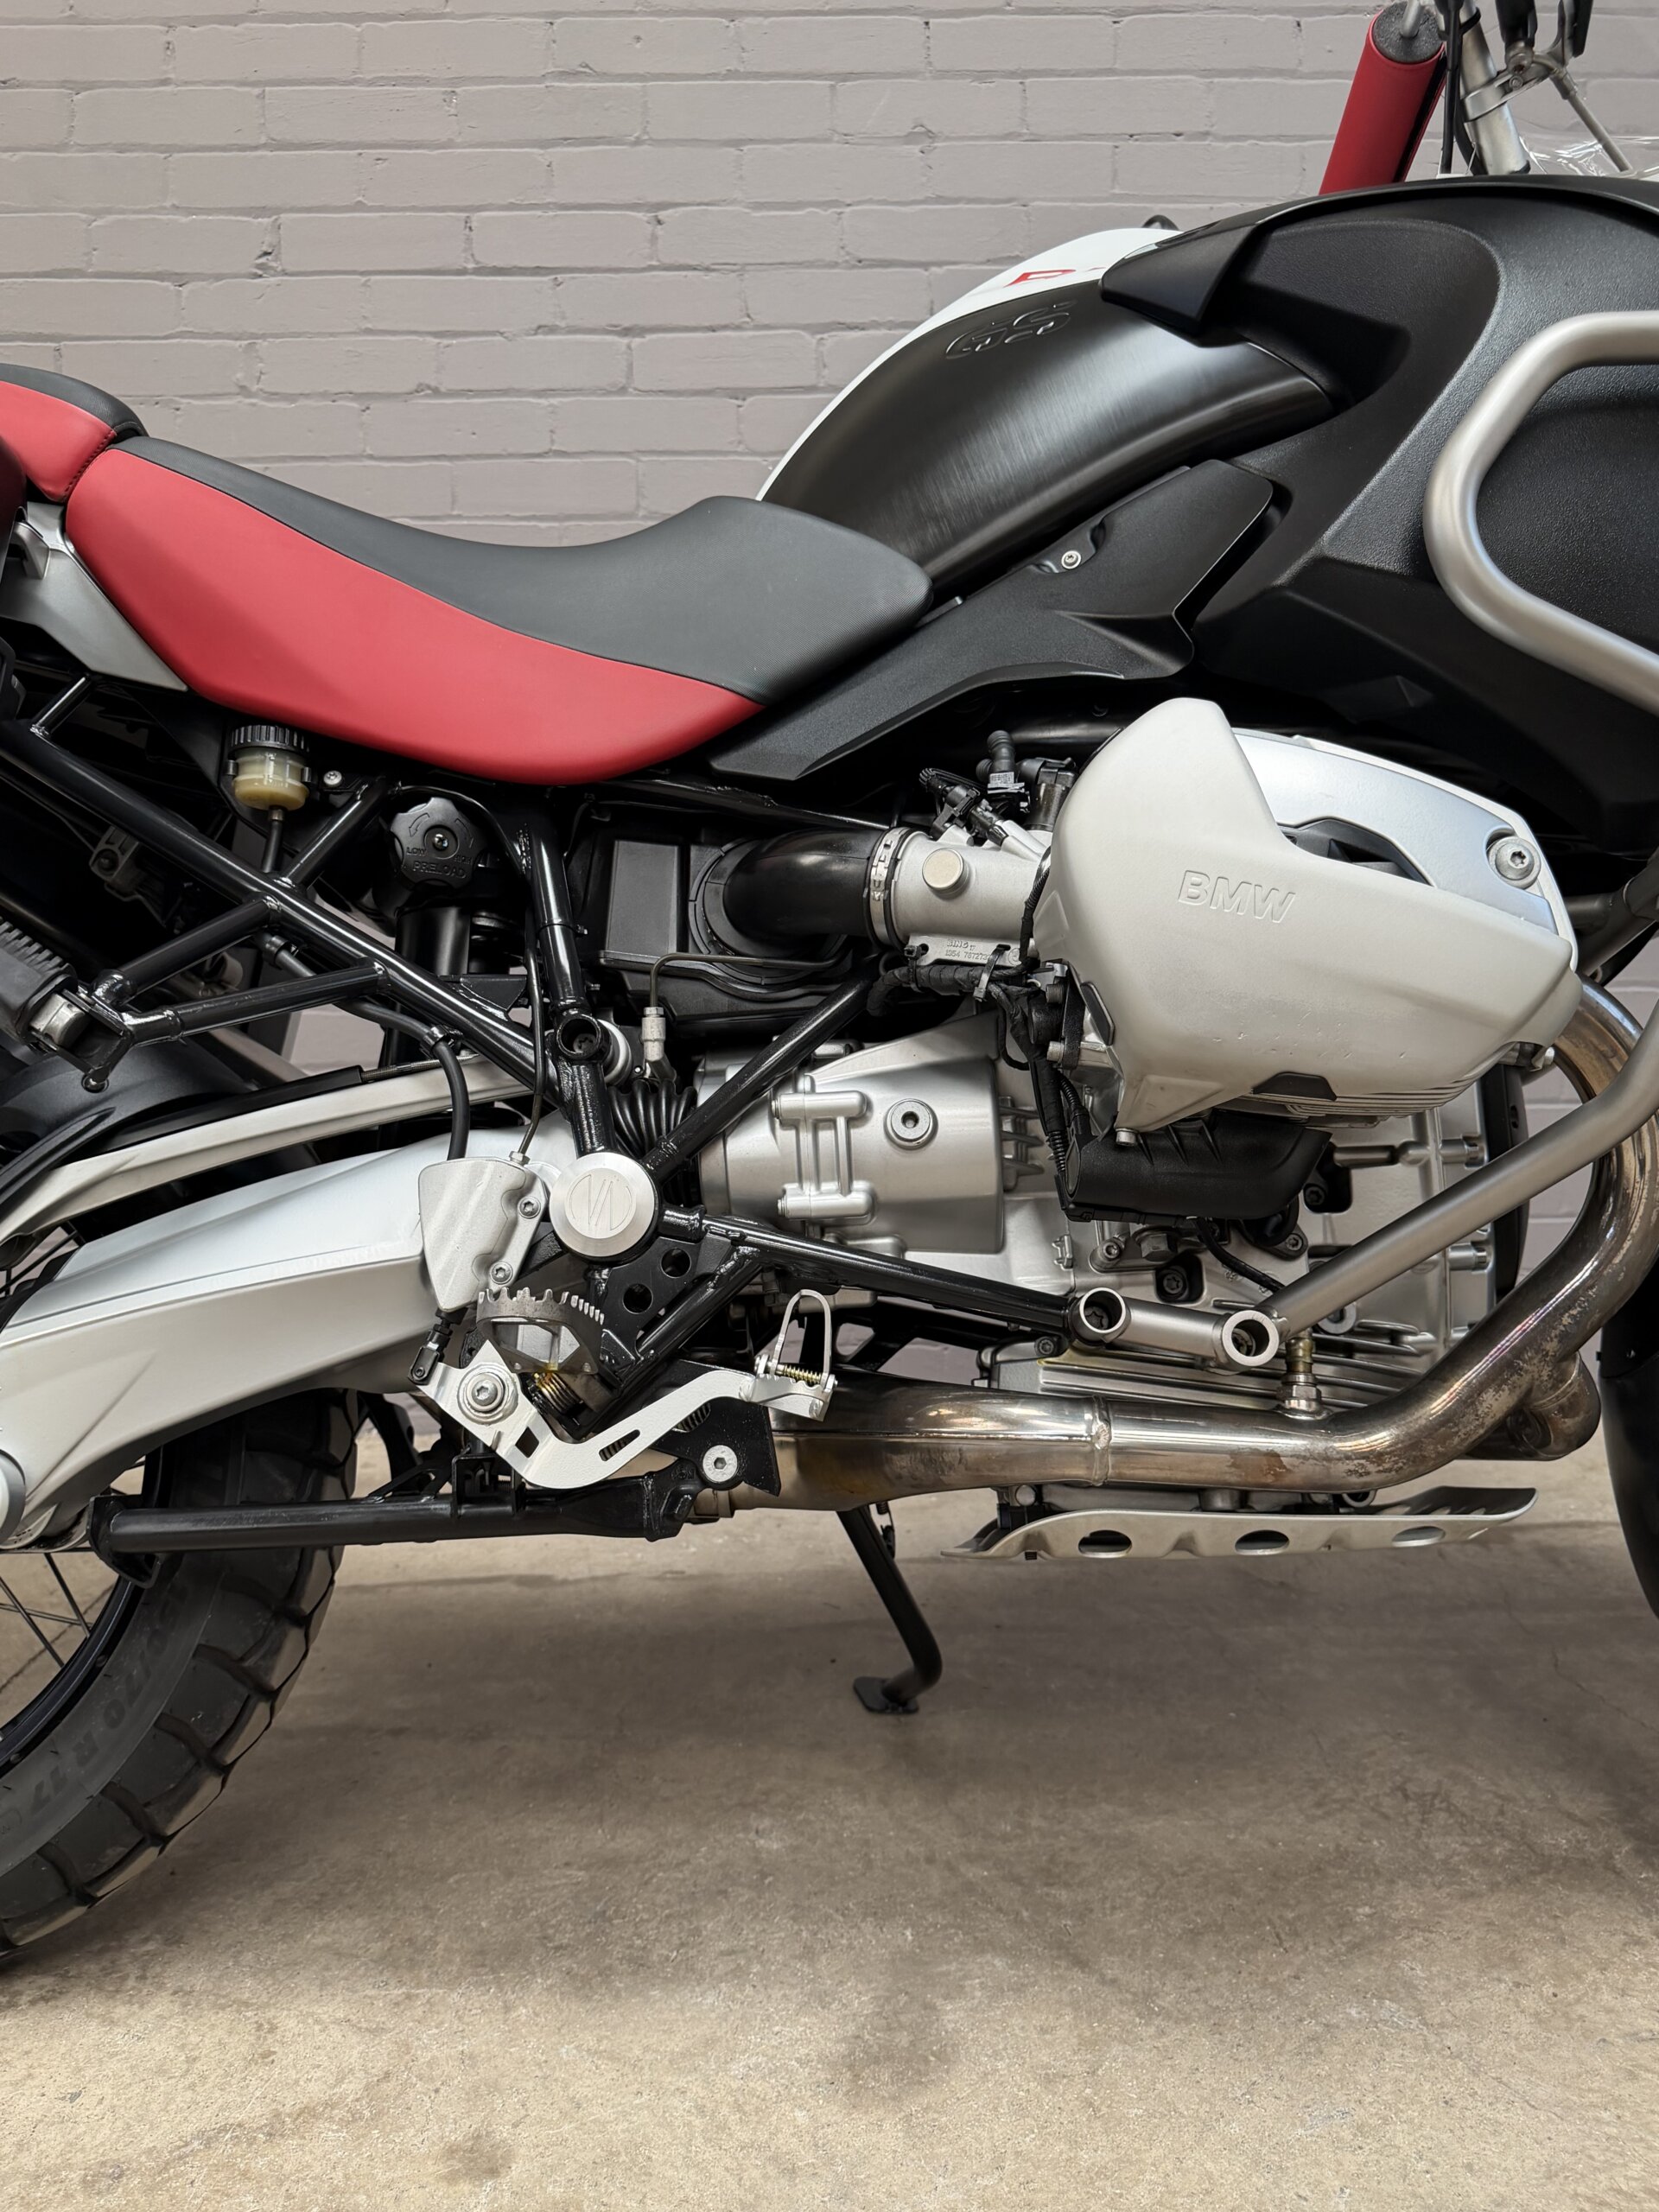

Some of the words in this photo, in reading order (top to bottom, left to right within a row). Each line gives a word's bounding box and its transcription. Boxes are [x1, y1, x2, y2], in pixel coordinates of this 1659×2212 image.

[412, 860, 467, 879] PRELOAD
[1178, 869, 1296, 924] BMW
[72, 1731, 100, 1768] R
[30, 1765, 70, 1815] 17
